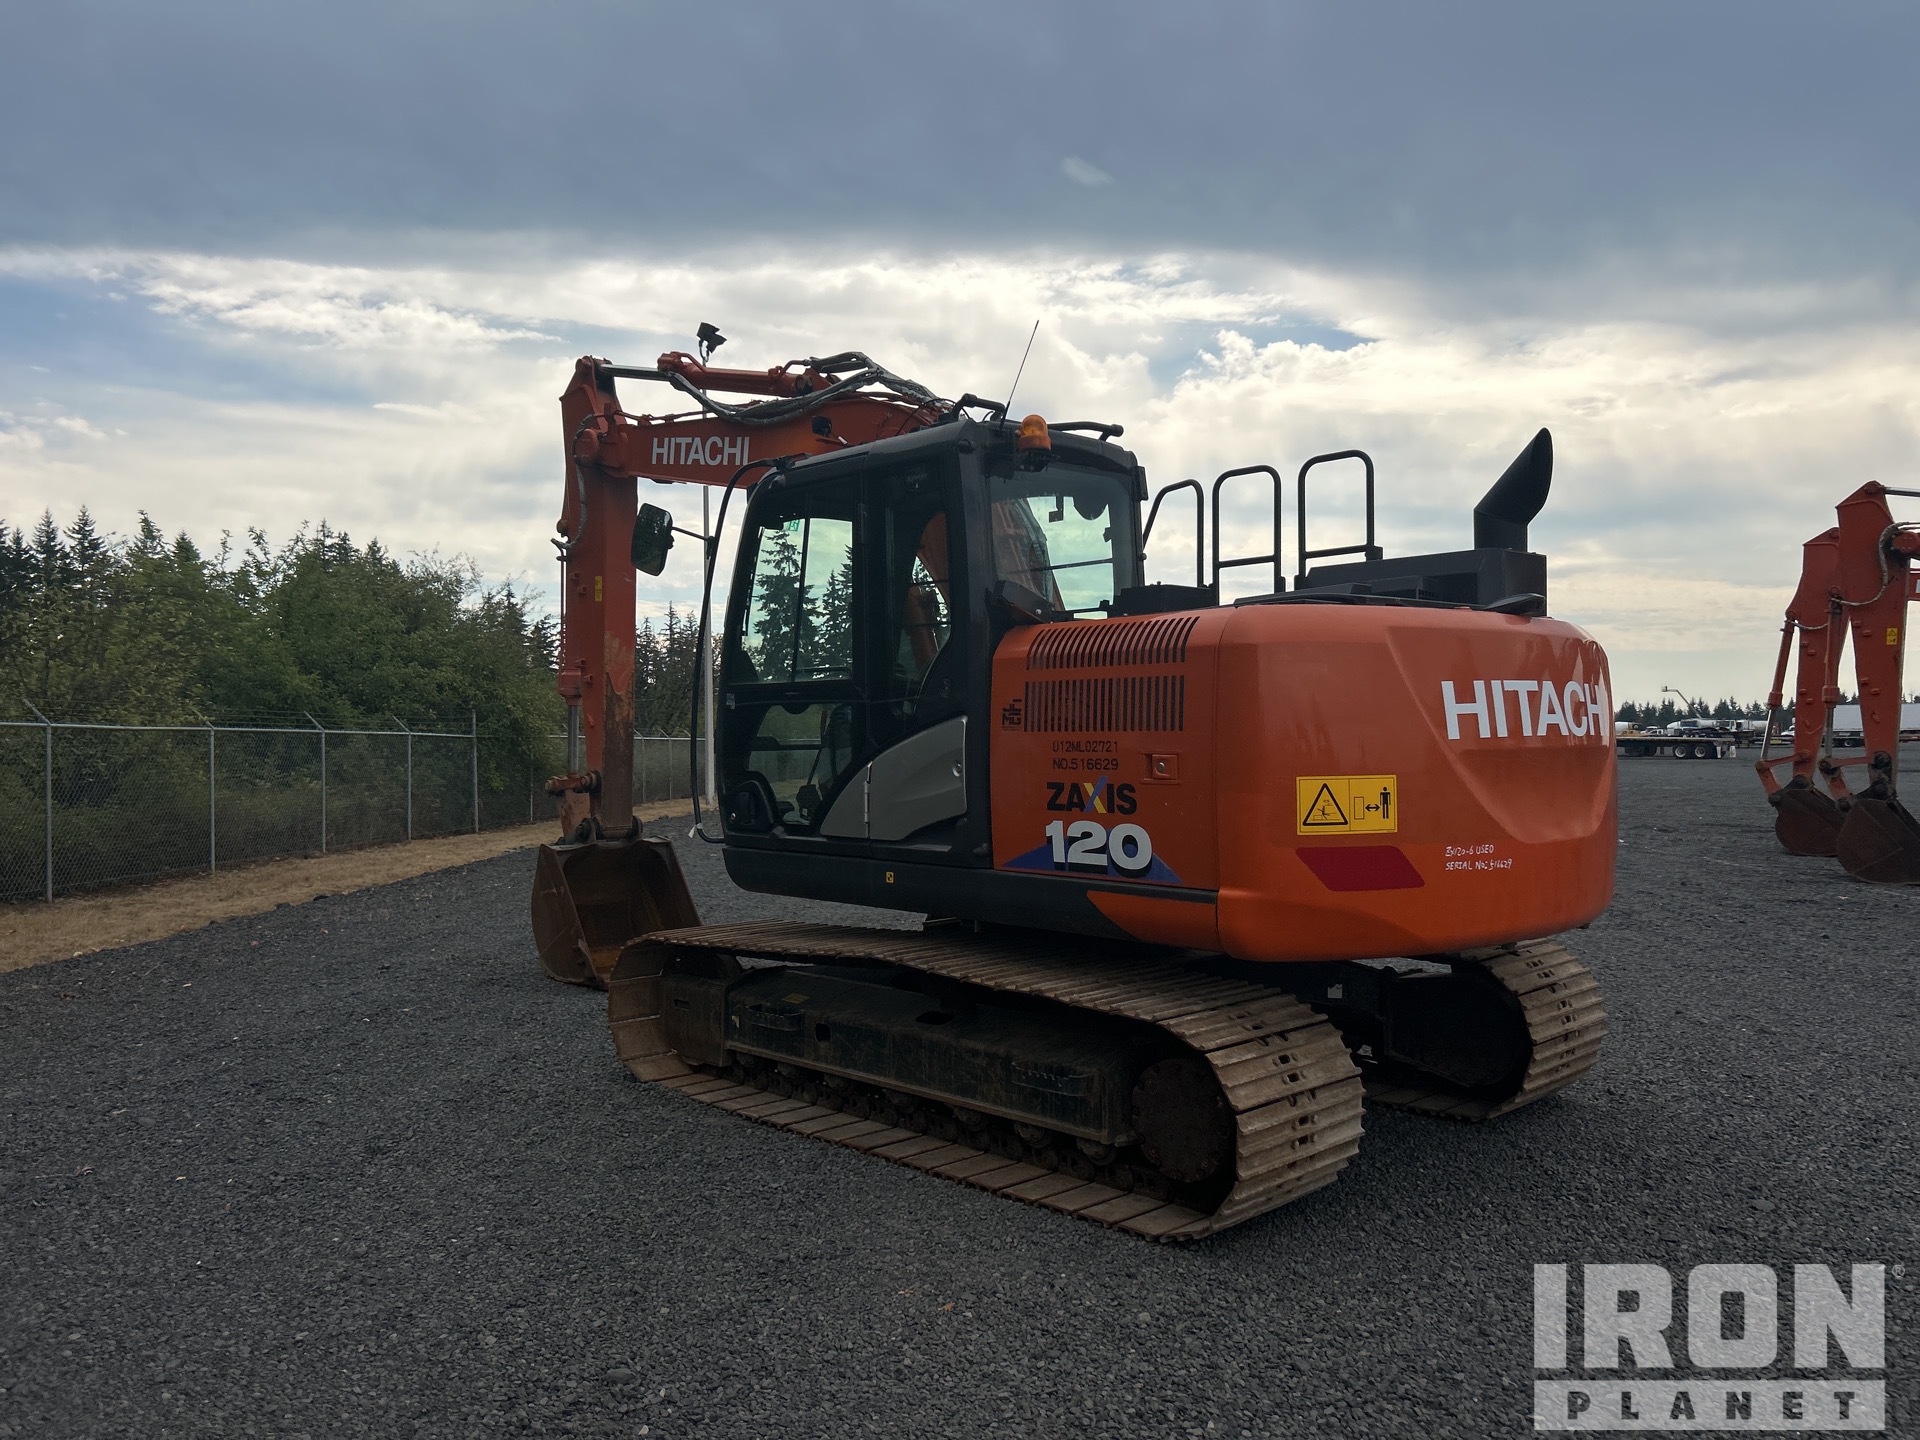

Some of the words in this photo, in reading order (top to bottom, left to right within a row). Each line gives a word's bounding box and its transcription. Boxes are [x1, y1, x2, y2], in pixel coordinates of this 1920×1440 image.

[651, 436, 750, 466] HITACHI
[1053, 740, 1118, 753] U12ML02721
[1046, 775, 1138, 815] ZAXIS
[1045, 820, 1153, 874] 120
[1445, 860, 1473, 871] SERIAL
